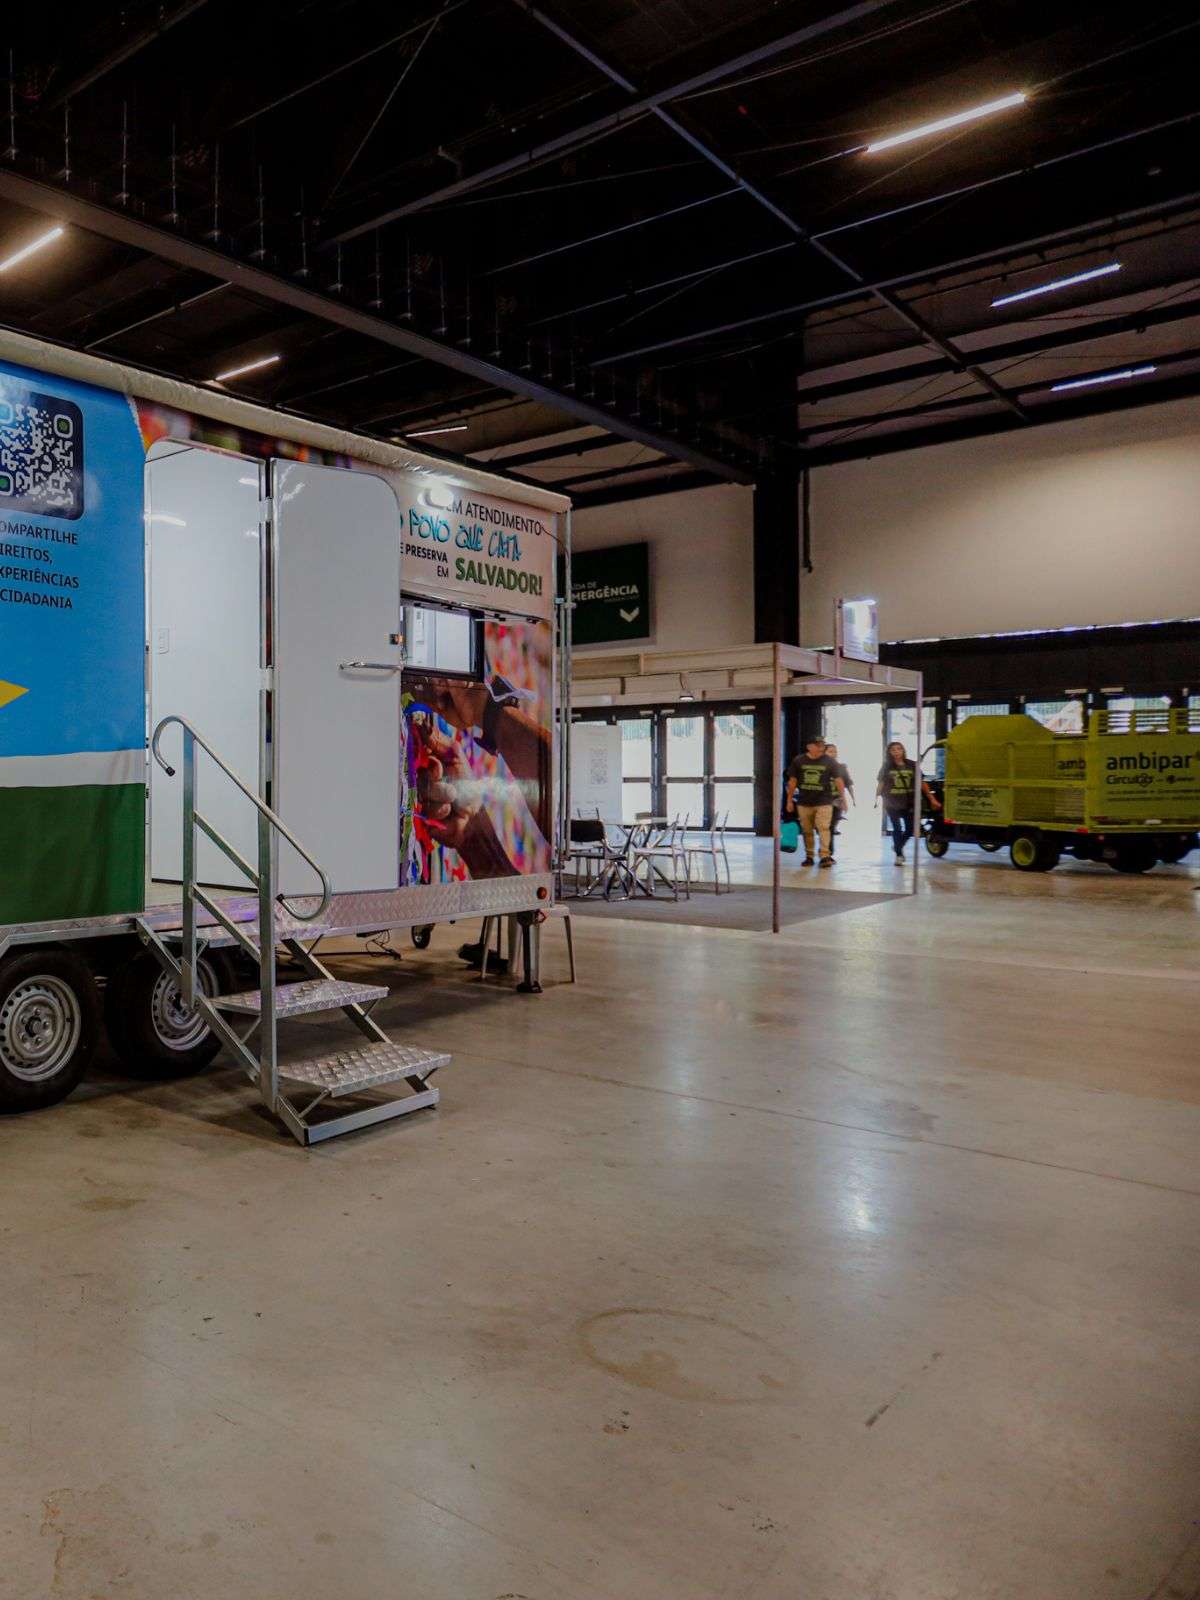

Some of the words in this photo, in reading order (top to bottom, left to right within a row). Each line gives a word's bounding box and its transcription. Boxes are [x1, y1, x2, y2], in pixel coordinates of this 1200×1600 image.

[465, 501, 542, 536] ATENDIMENTO
[408, 507, 450, 543] POVO
[455, 523, 483, 552] QUE
[405, 543, 448, 564] PRESERVA
[437, 565, 449, 578] EM
[455, 556, 543, 596] SALVADOR!
[0, 588, 73, 609] CIDADANIA
[571, 584, 639, 601] MERGÊNCIA
[1105, 751, 1193, 773] ambipar
